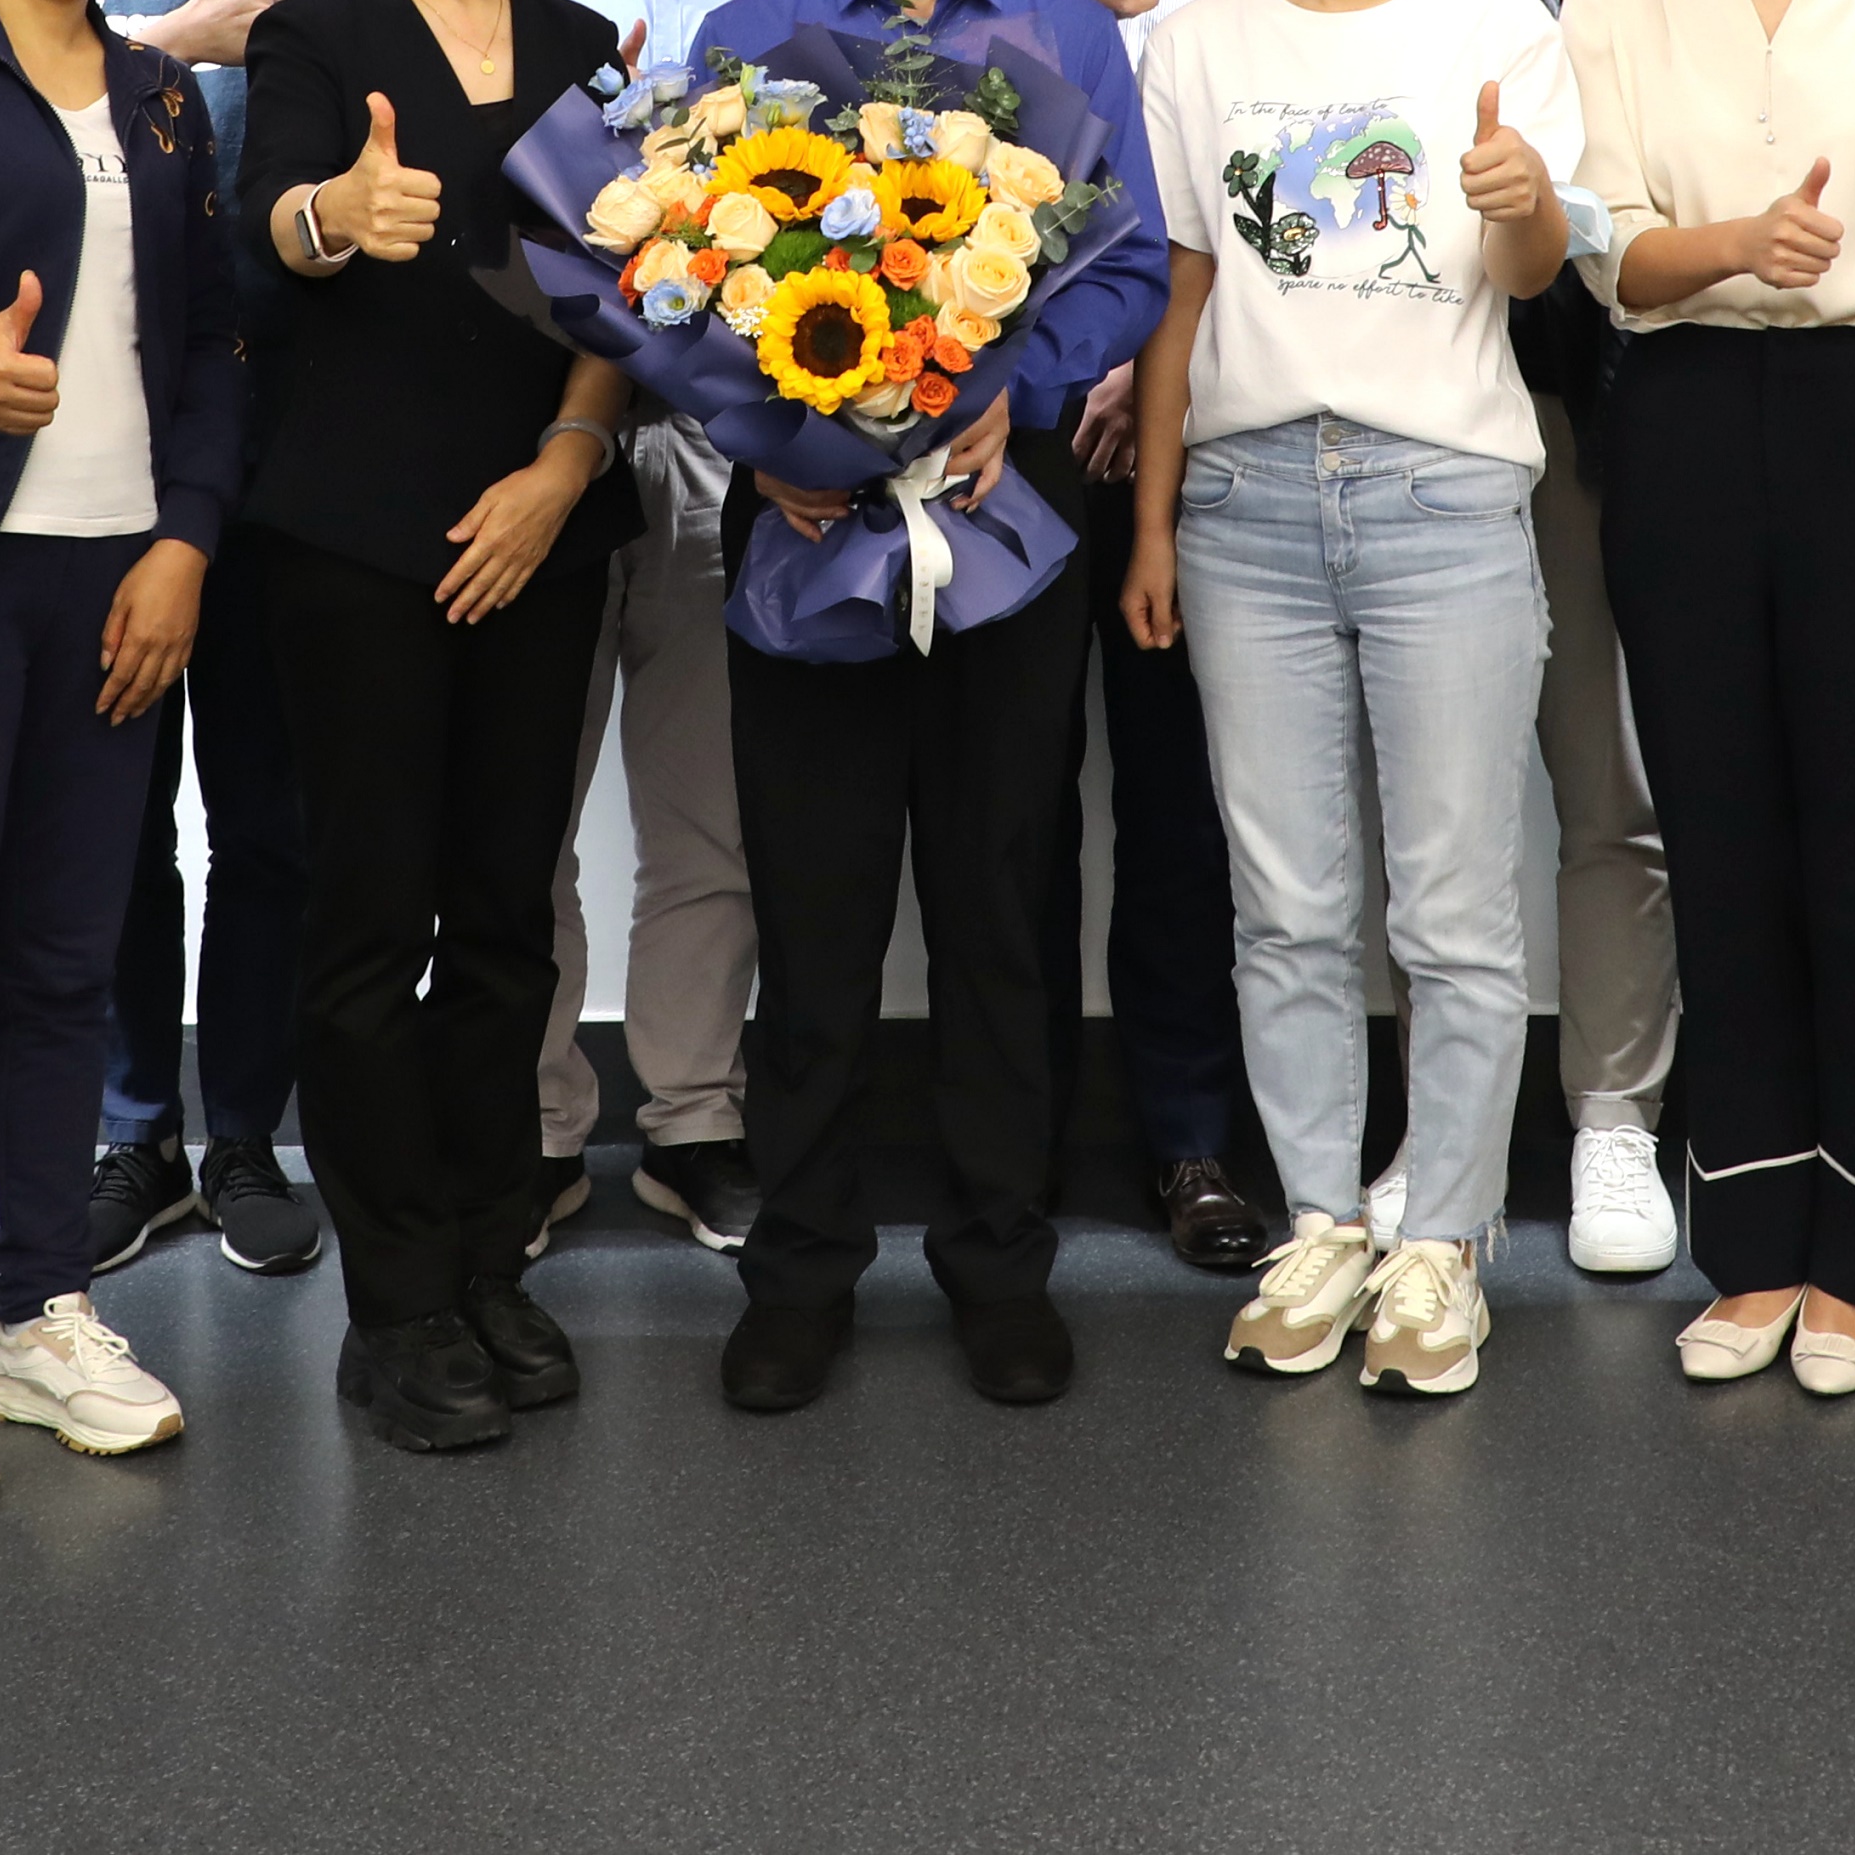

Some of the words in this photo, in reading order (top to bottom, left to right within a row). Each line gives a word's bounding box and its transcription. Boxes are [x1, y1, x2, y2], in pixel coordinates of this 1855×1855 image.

[1250, 101, 1282, 116] the
[1317, 104, 1334, 121] of
[1327, 281, 1347, 291] no
[1406, 282, 1428, 299] to
